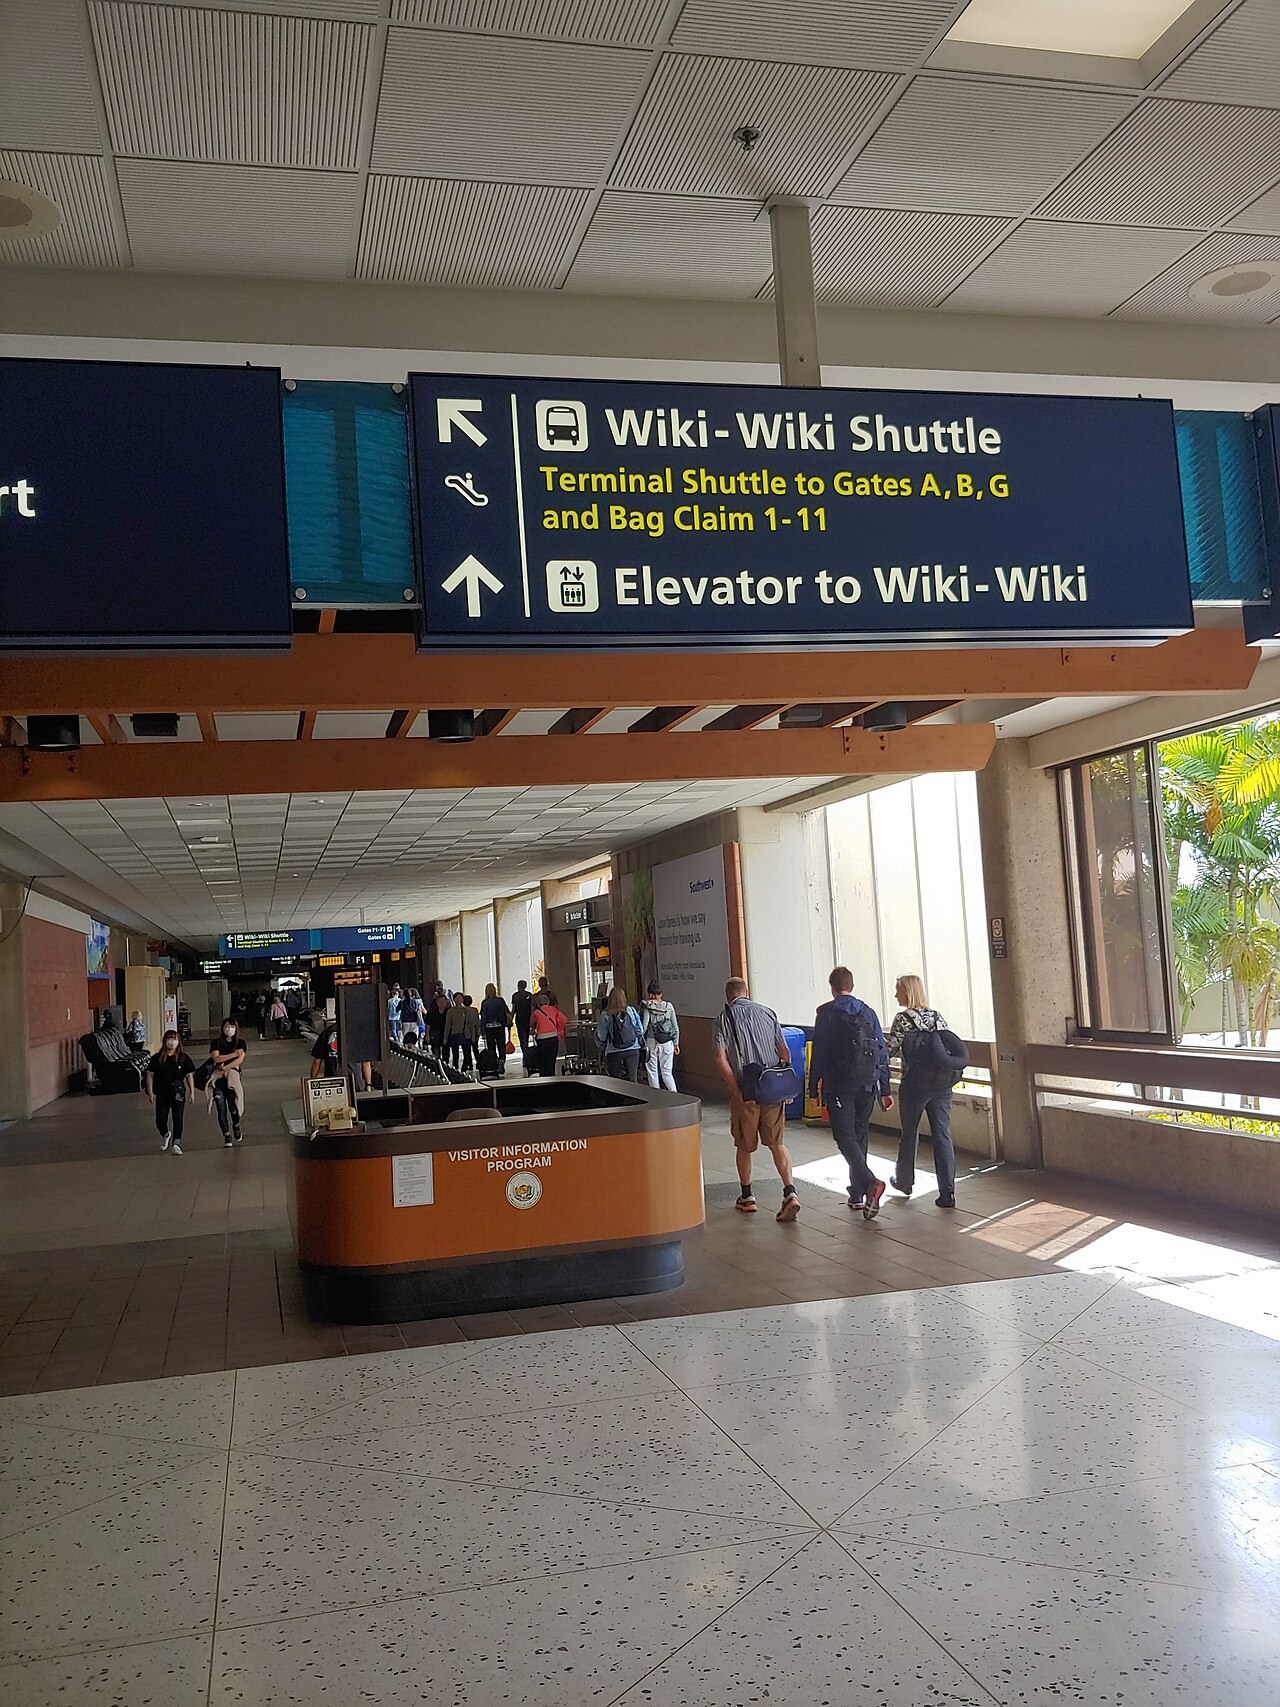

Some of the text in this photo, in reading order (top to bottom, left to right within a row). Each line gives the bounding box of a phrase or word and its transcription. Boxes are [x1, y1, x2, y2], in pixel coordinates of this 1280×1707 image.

[604, 408, 1002, 456] Wiki-Wiki Shuttle
[539, 466, 673, 494] Terminal
[682, 468, 787, 496] Shuttle
[793, 472, 825, 496] to
[833, 471, 912, 497] Gates
[989, 474, 1010, 498] G
[542, 503, 828, 537] and Bag Claim 1-11
[615, 564, 1089, 606] Elevator to Wiki-Wiki
[356, 956, 365, 964] F1
[448, 1138, 588, 1162] VISITOR INFORMATION
[487, 1155, 552, 1172] PROGRAM
